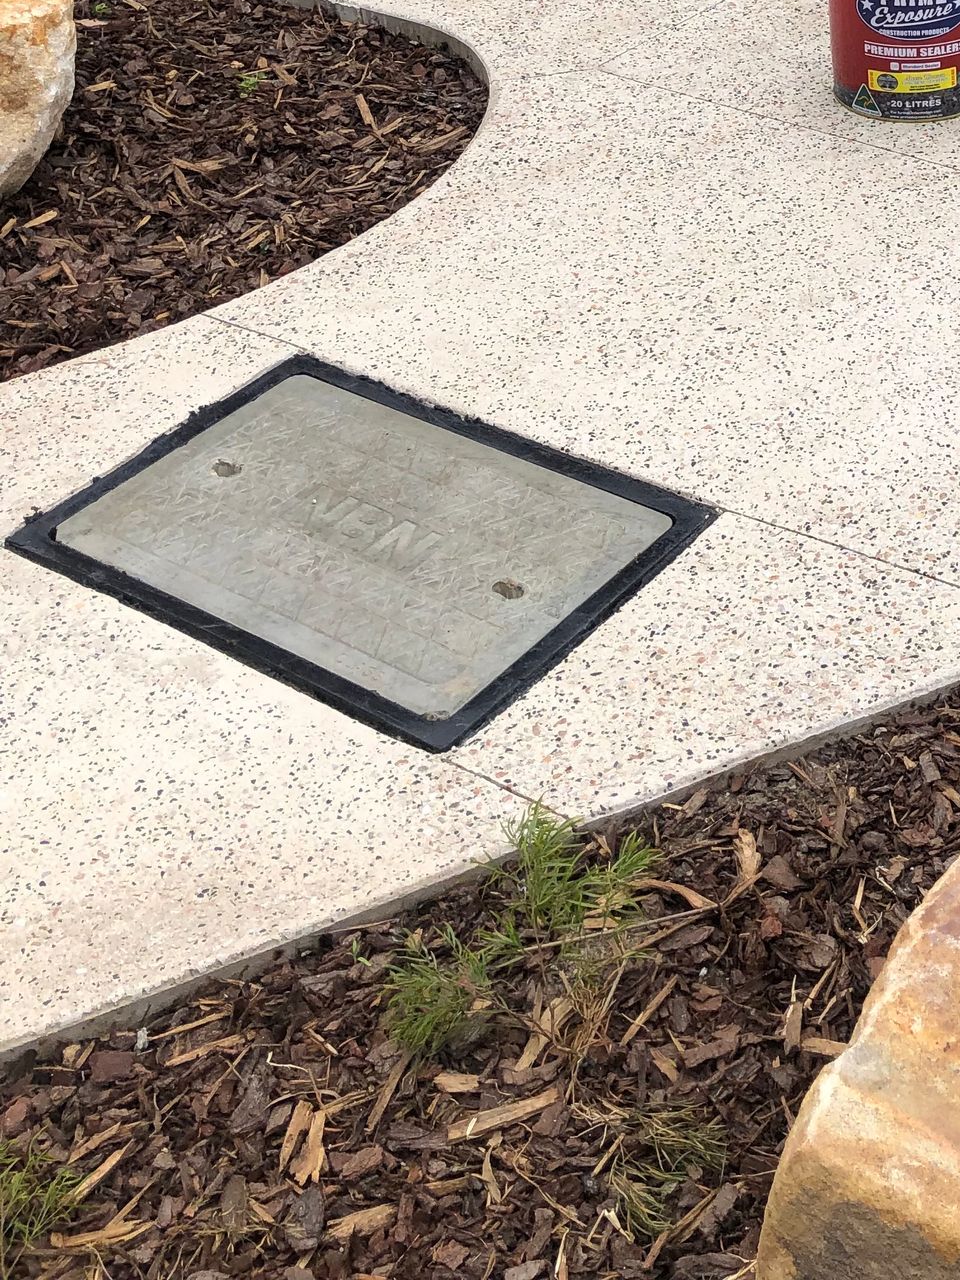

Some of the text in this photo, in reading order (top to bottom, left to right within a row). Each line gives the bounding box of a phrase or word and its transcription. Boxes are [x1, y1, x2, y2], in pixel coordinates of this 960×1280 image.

[870, 2, 953, 27] Exposure
[879, 27, 950, 37] CONSTRUCTION PRODUCTS
[864, 43, 917, 57] PREMIUM
[890, 98, 942, 108] 20 LITRES
